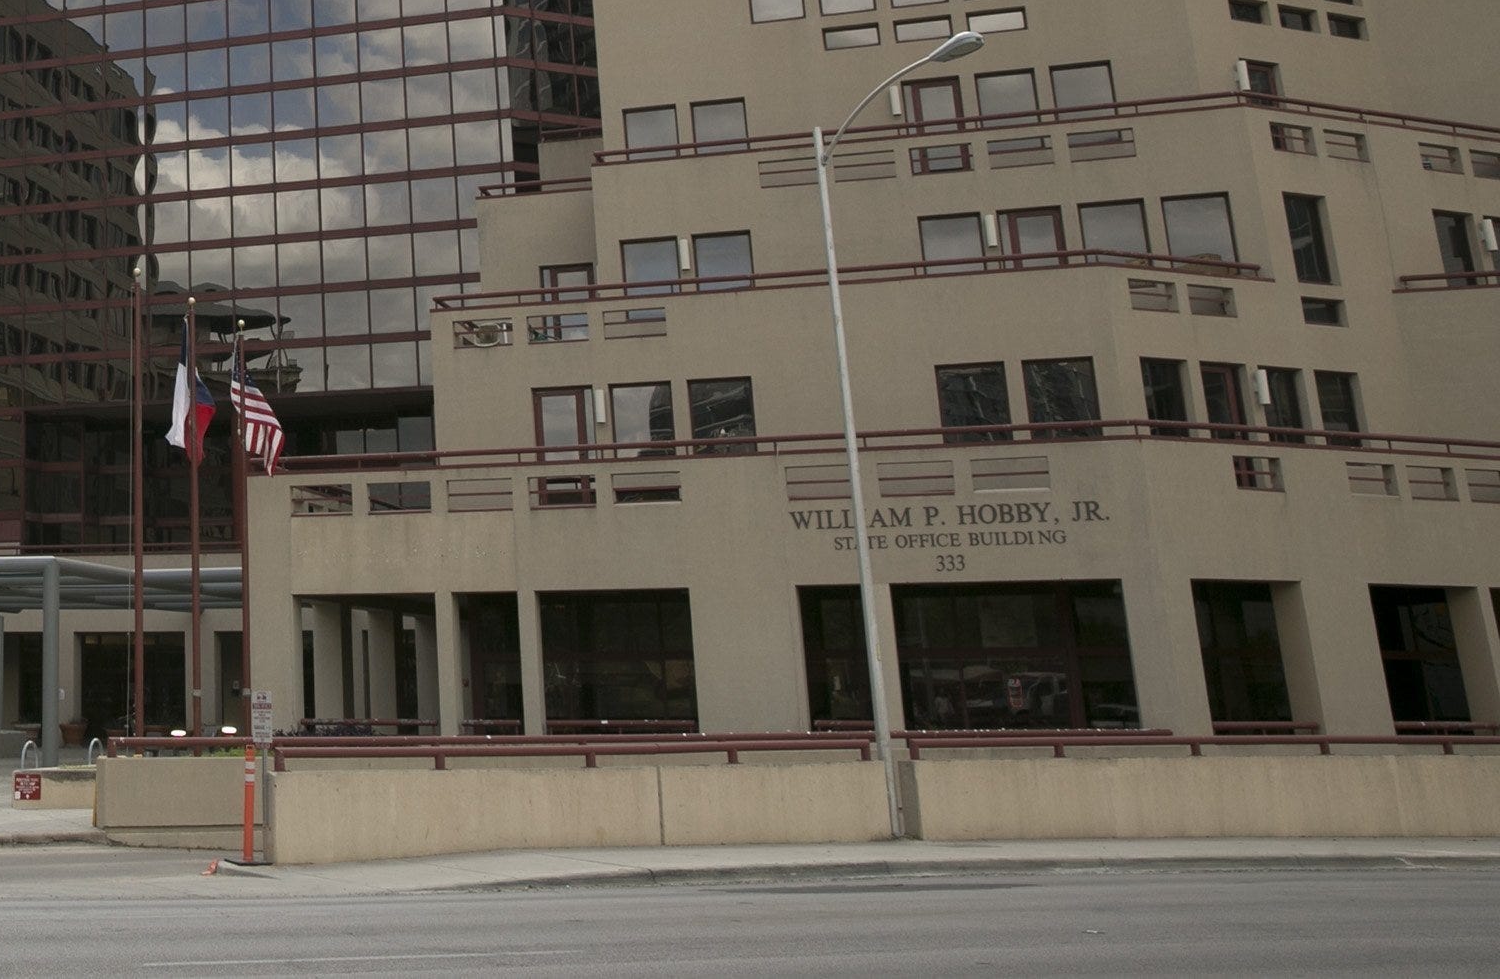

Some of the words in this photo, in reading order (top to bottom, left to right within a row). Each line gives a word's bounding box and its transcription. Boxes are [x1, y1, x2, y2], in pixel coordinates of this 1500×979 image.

[789, 506, 913, 530] WILLAM
[923, 506, 946, 526] P.
[956, 502, 1060, 525] HOBBY,
[1072, 500, 1111, 522] JR.
[834, 535, 889, 551] STTE
[895, 533, 962, 549] OFFICE
[968, 529, 1067, 547] BUILDING
[936, 554, 966, 572] 333
